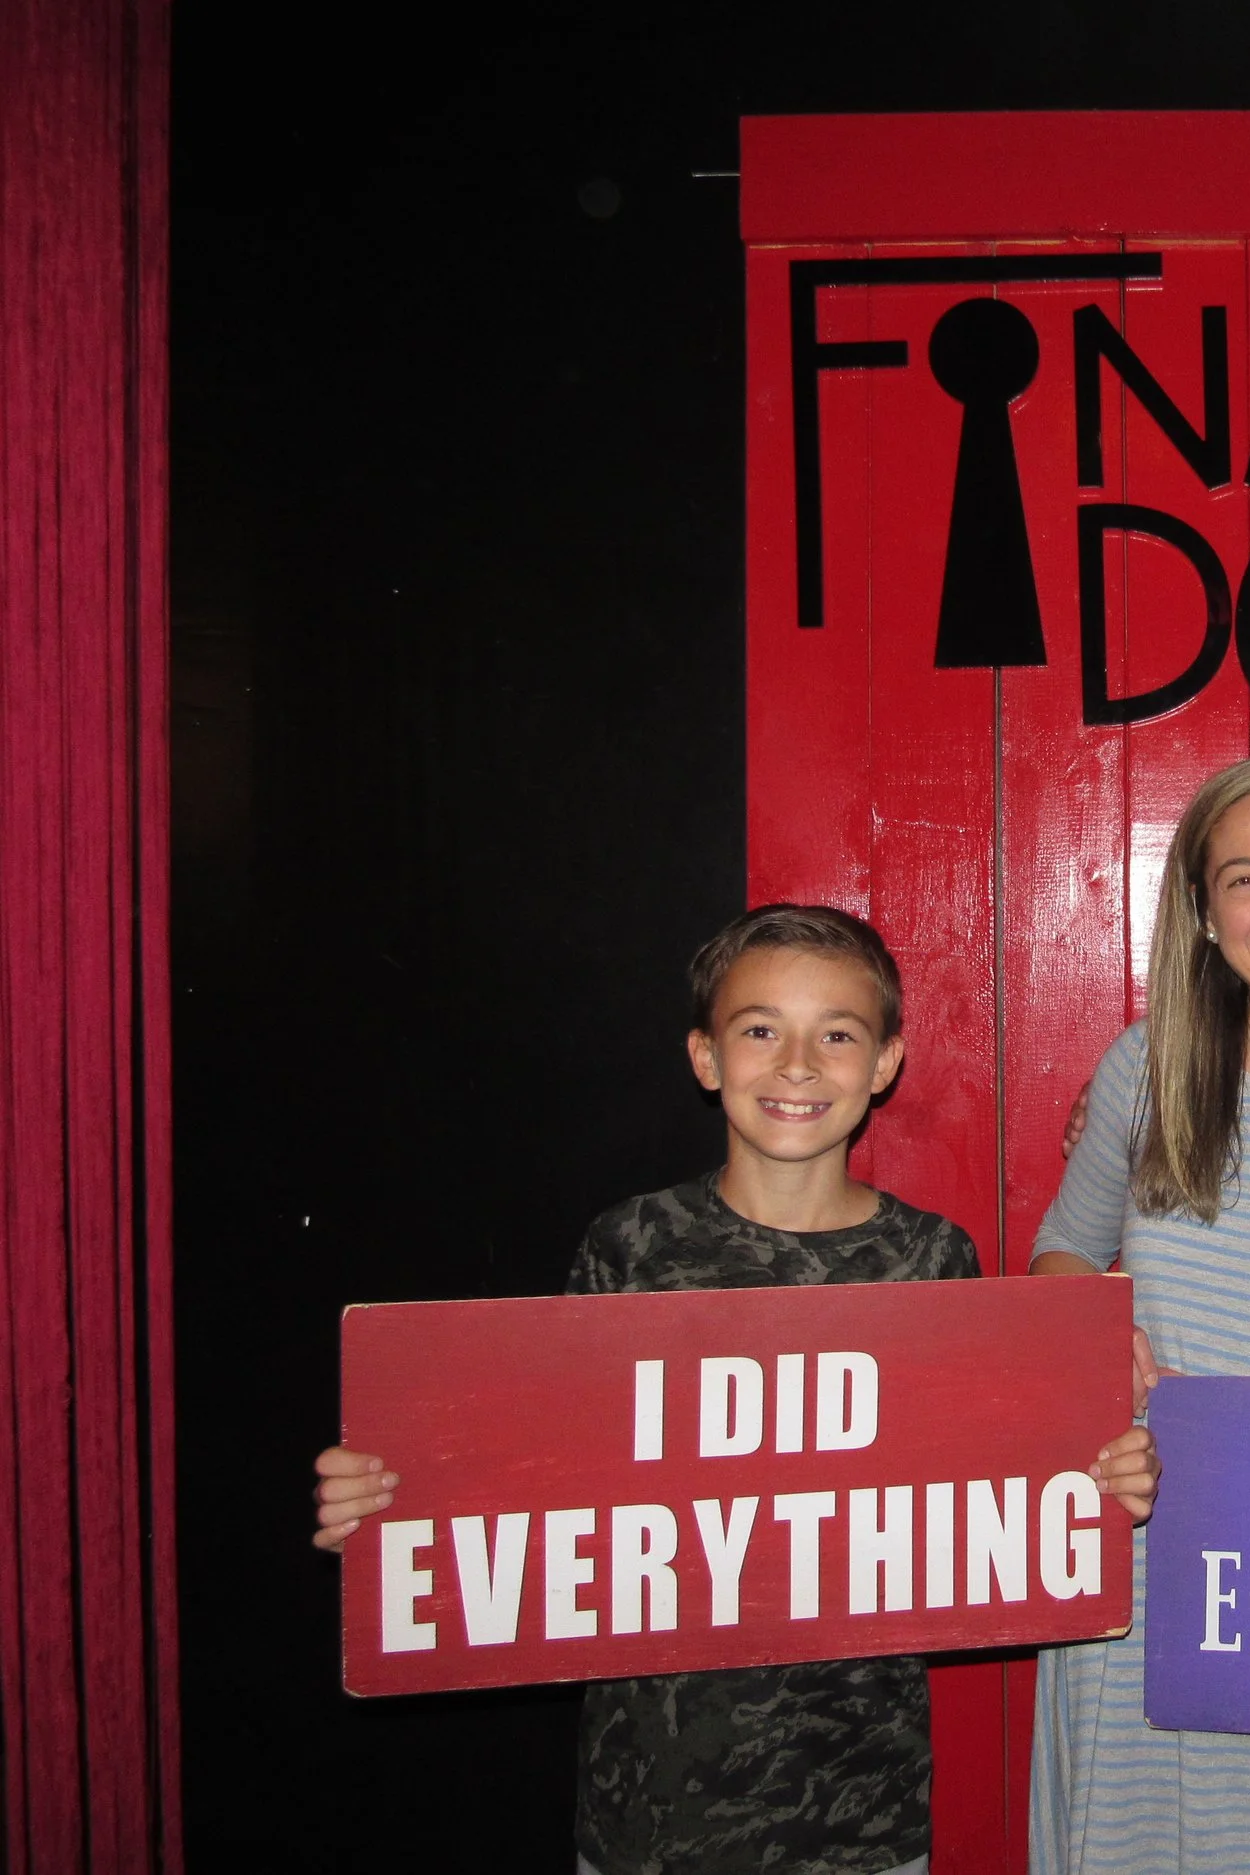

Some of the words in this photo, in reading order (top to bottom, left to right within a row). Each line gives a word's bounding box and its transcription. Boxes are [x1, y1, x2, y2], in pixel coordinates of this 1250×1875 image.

[633, 1358, 665, 1462] I
[698, 1351, 880, 1458] DID
[380, 1470, 1103, 1654] EVERYTHING
